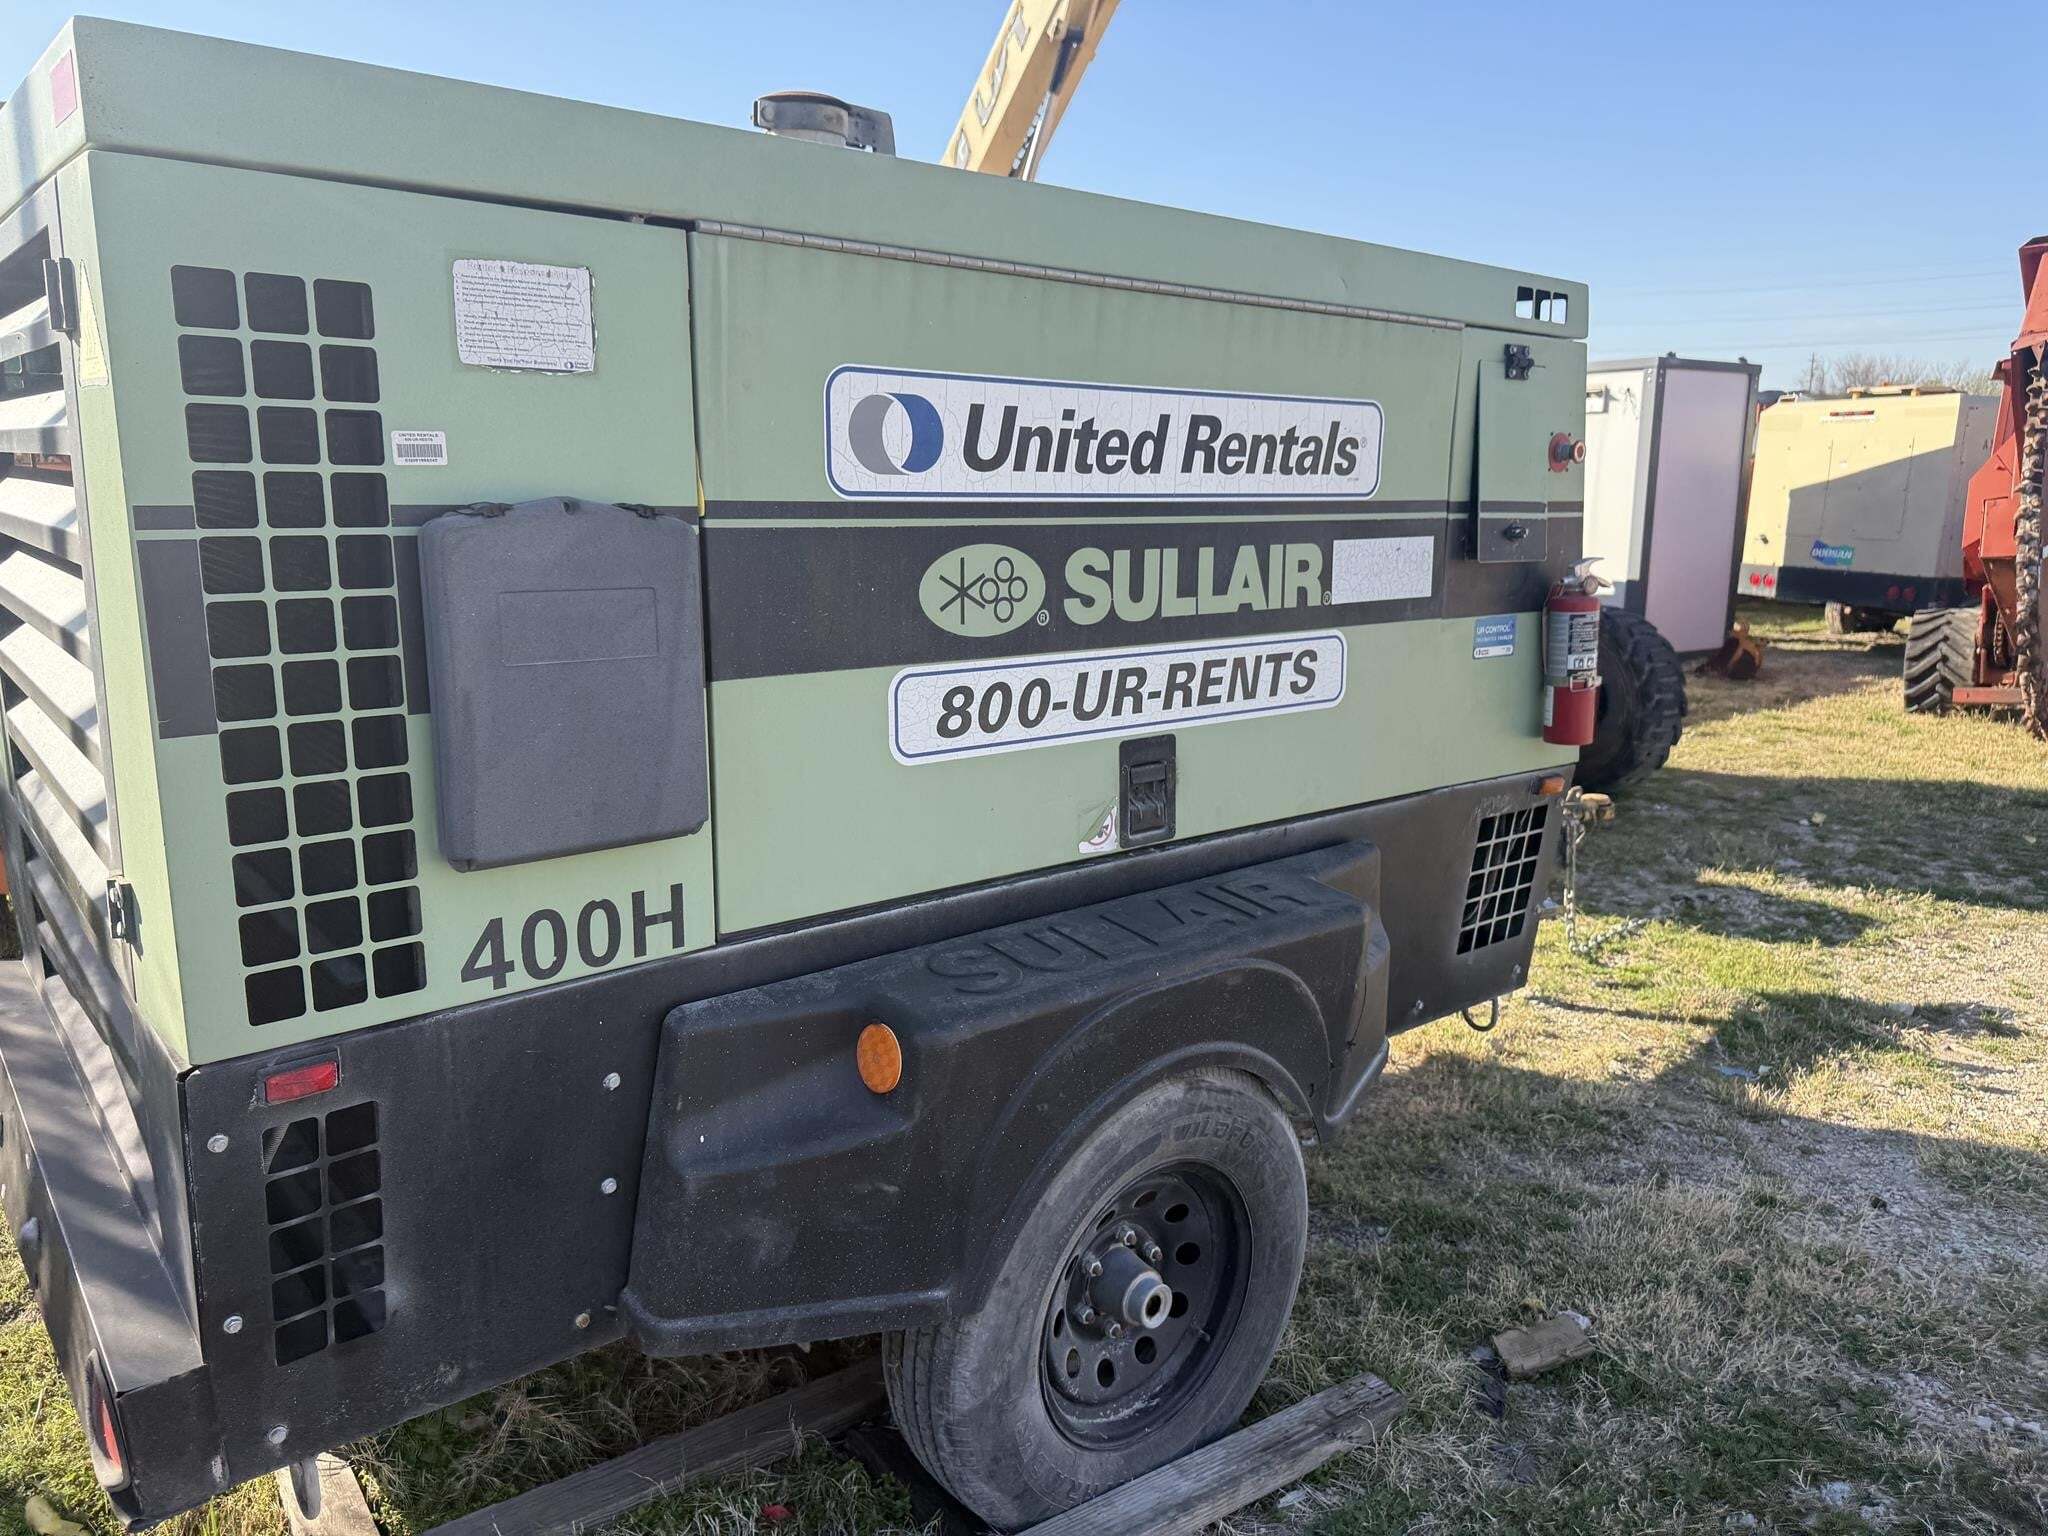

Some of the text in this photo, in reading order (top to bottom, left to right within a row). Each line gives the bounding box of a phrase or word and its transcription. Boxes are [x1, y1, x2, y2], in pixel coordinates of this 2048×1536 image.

[963, 403, 1360, 476] United Rentals
[1064, 543, 1323, 626] SULLAIR
[935, 649, 1319, 739] 800-UR-RENTS
[460, 883, 685, 991] 400H
[926, 883, 1310, 995] SULLAIR
